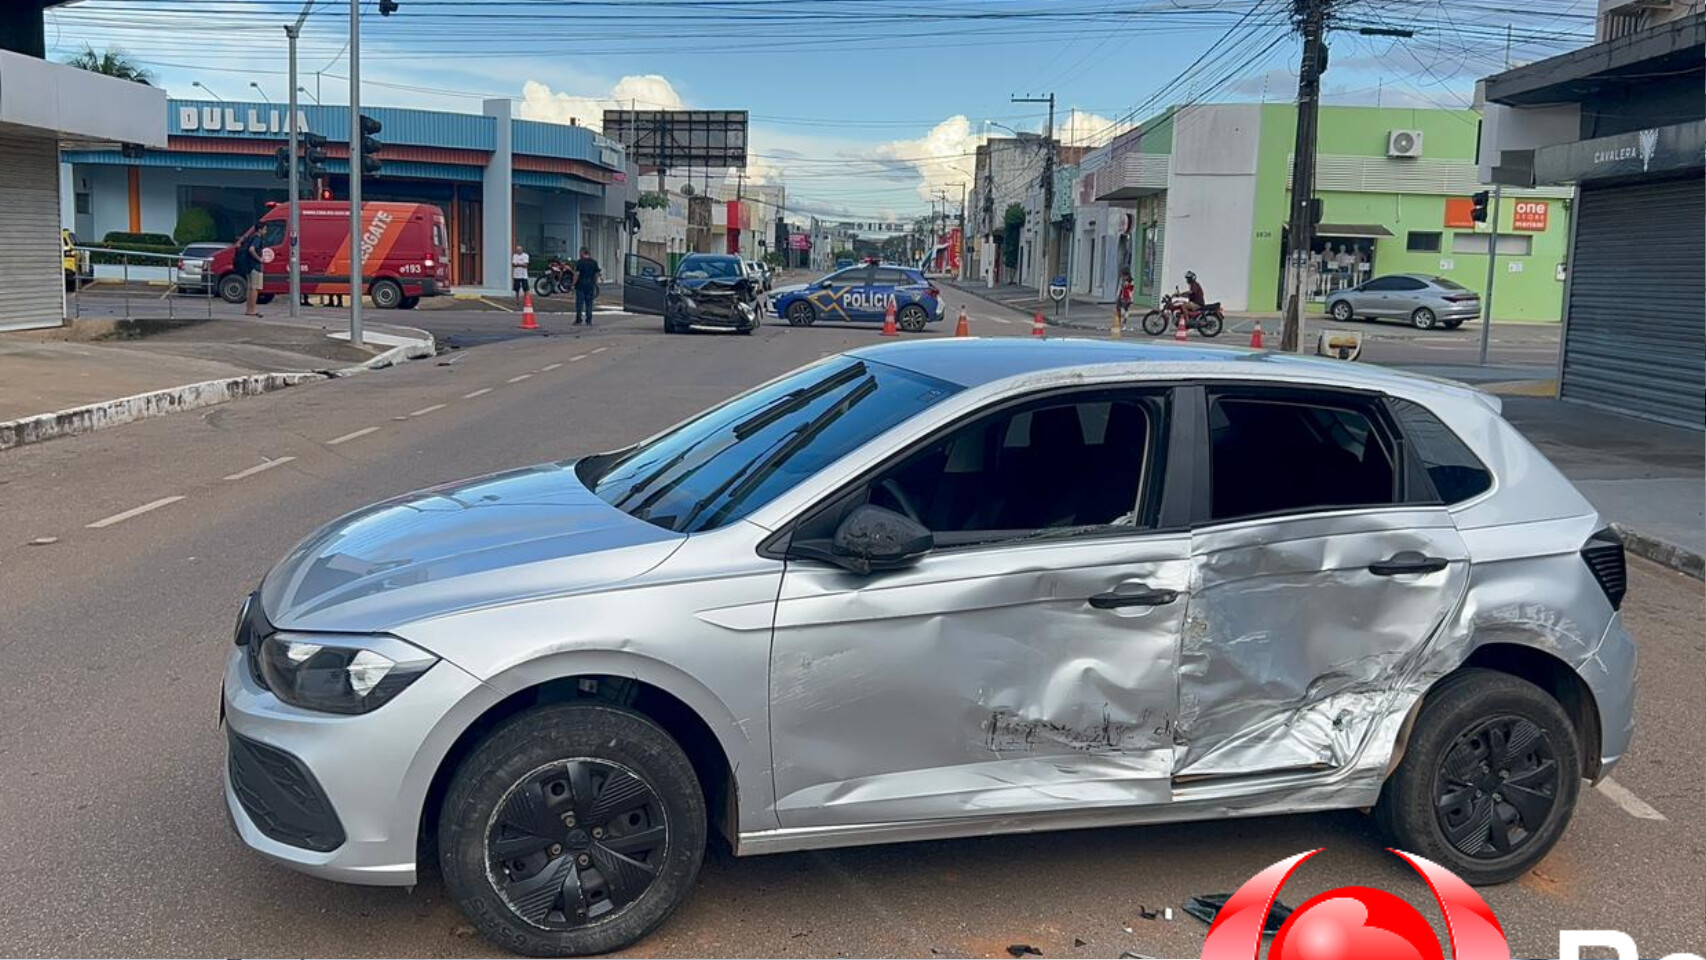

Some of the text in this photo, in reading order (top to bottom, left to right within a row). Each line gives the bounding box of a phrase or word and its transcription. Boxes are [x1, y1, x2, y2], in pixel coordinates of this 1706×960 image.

[1593, 147, 1637, 163] CAVALERA
[1516, 203, 1546, 214] one
[404, 264, 421, 273] 193
[843, 291, 897, 308] POLÍCIA
